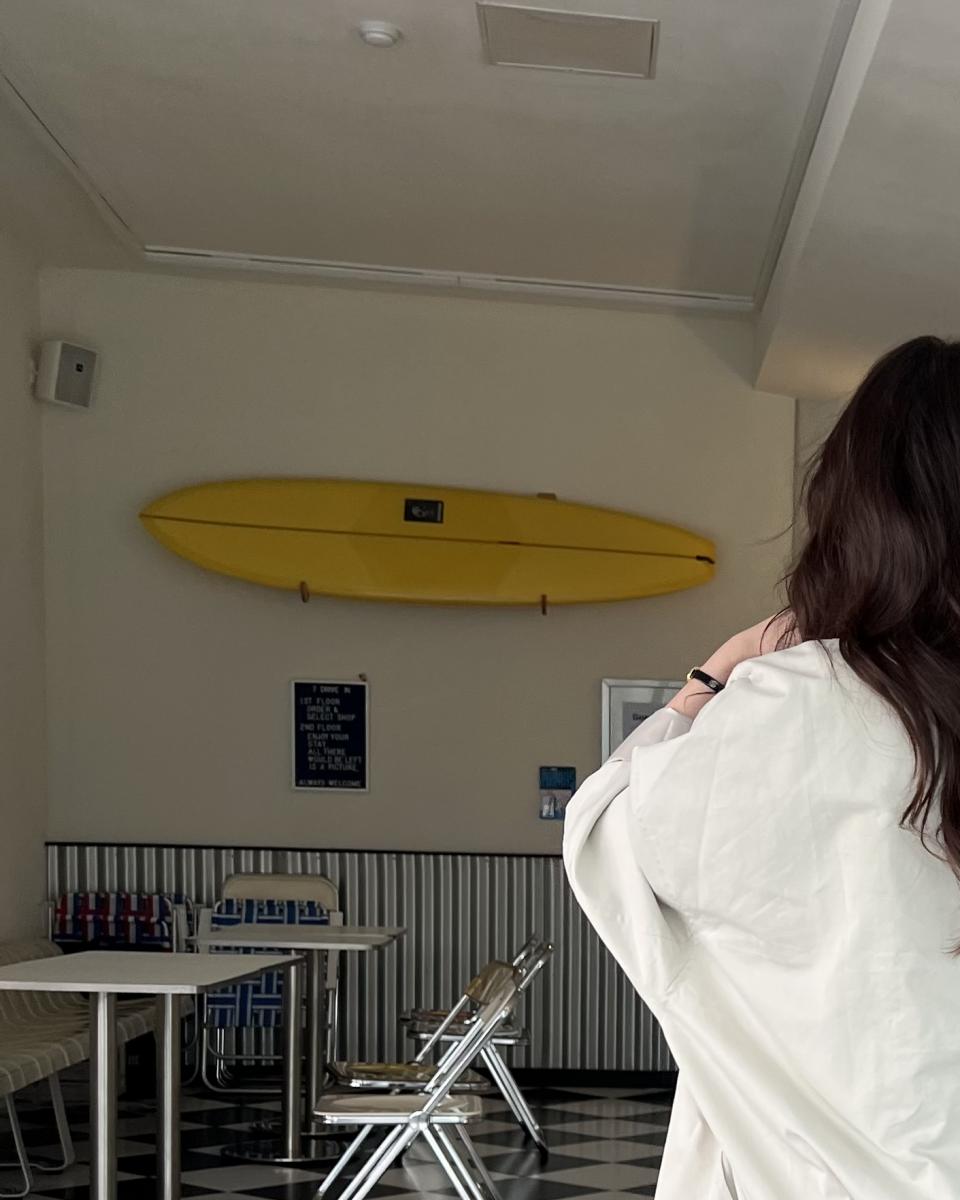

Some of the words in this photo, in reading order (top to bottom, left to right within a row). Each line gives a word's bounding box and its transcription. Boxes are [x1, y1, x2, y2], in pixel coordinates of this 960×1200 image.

[317, 697, 341, 705] FLOOR
[307, 705, 331, 713] ORDER
[307, 712, 333, 721] SELECT
[338, 713, 356, 721] SHOP
[300, 723, 314, 731] 2ND
[318, 723, 342, 732] FLOOR
[308, 732, 329, 741] ENJOY
[331, 733, 350, 741] YOUR
[329, 779, 361, 787] WELCOME
